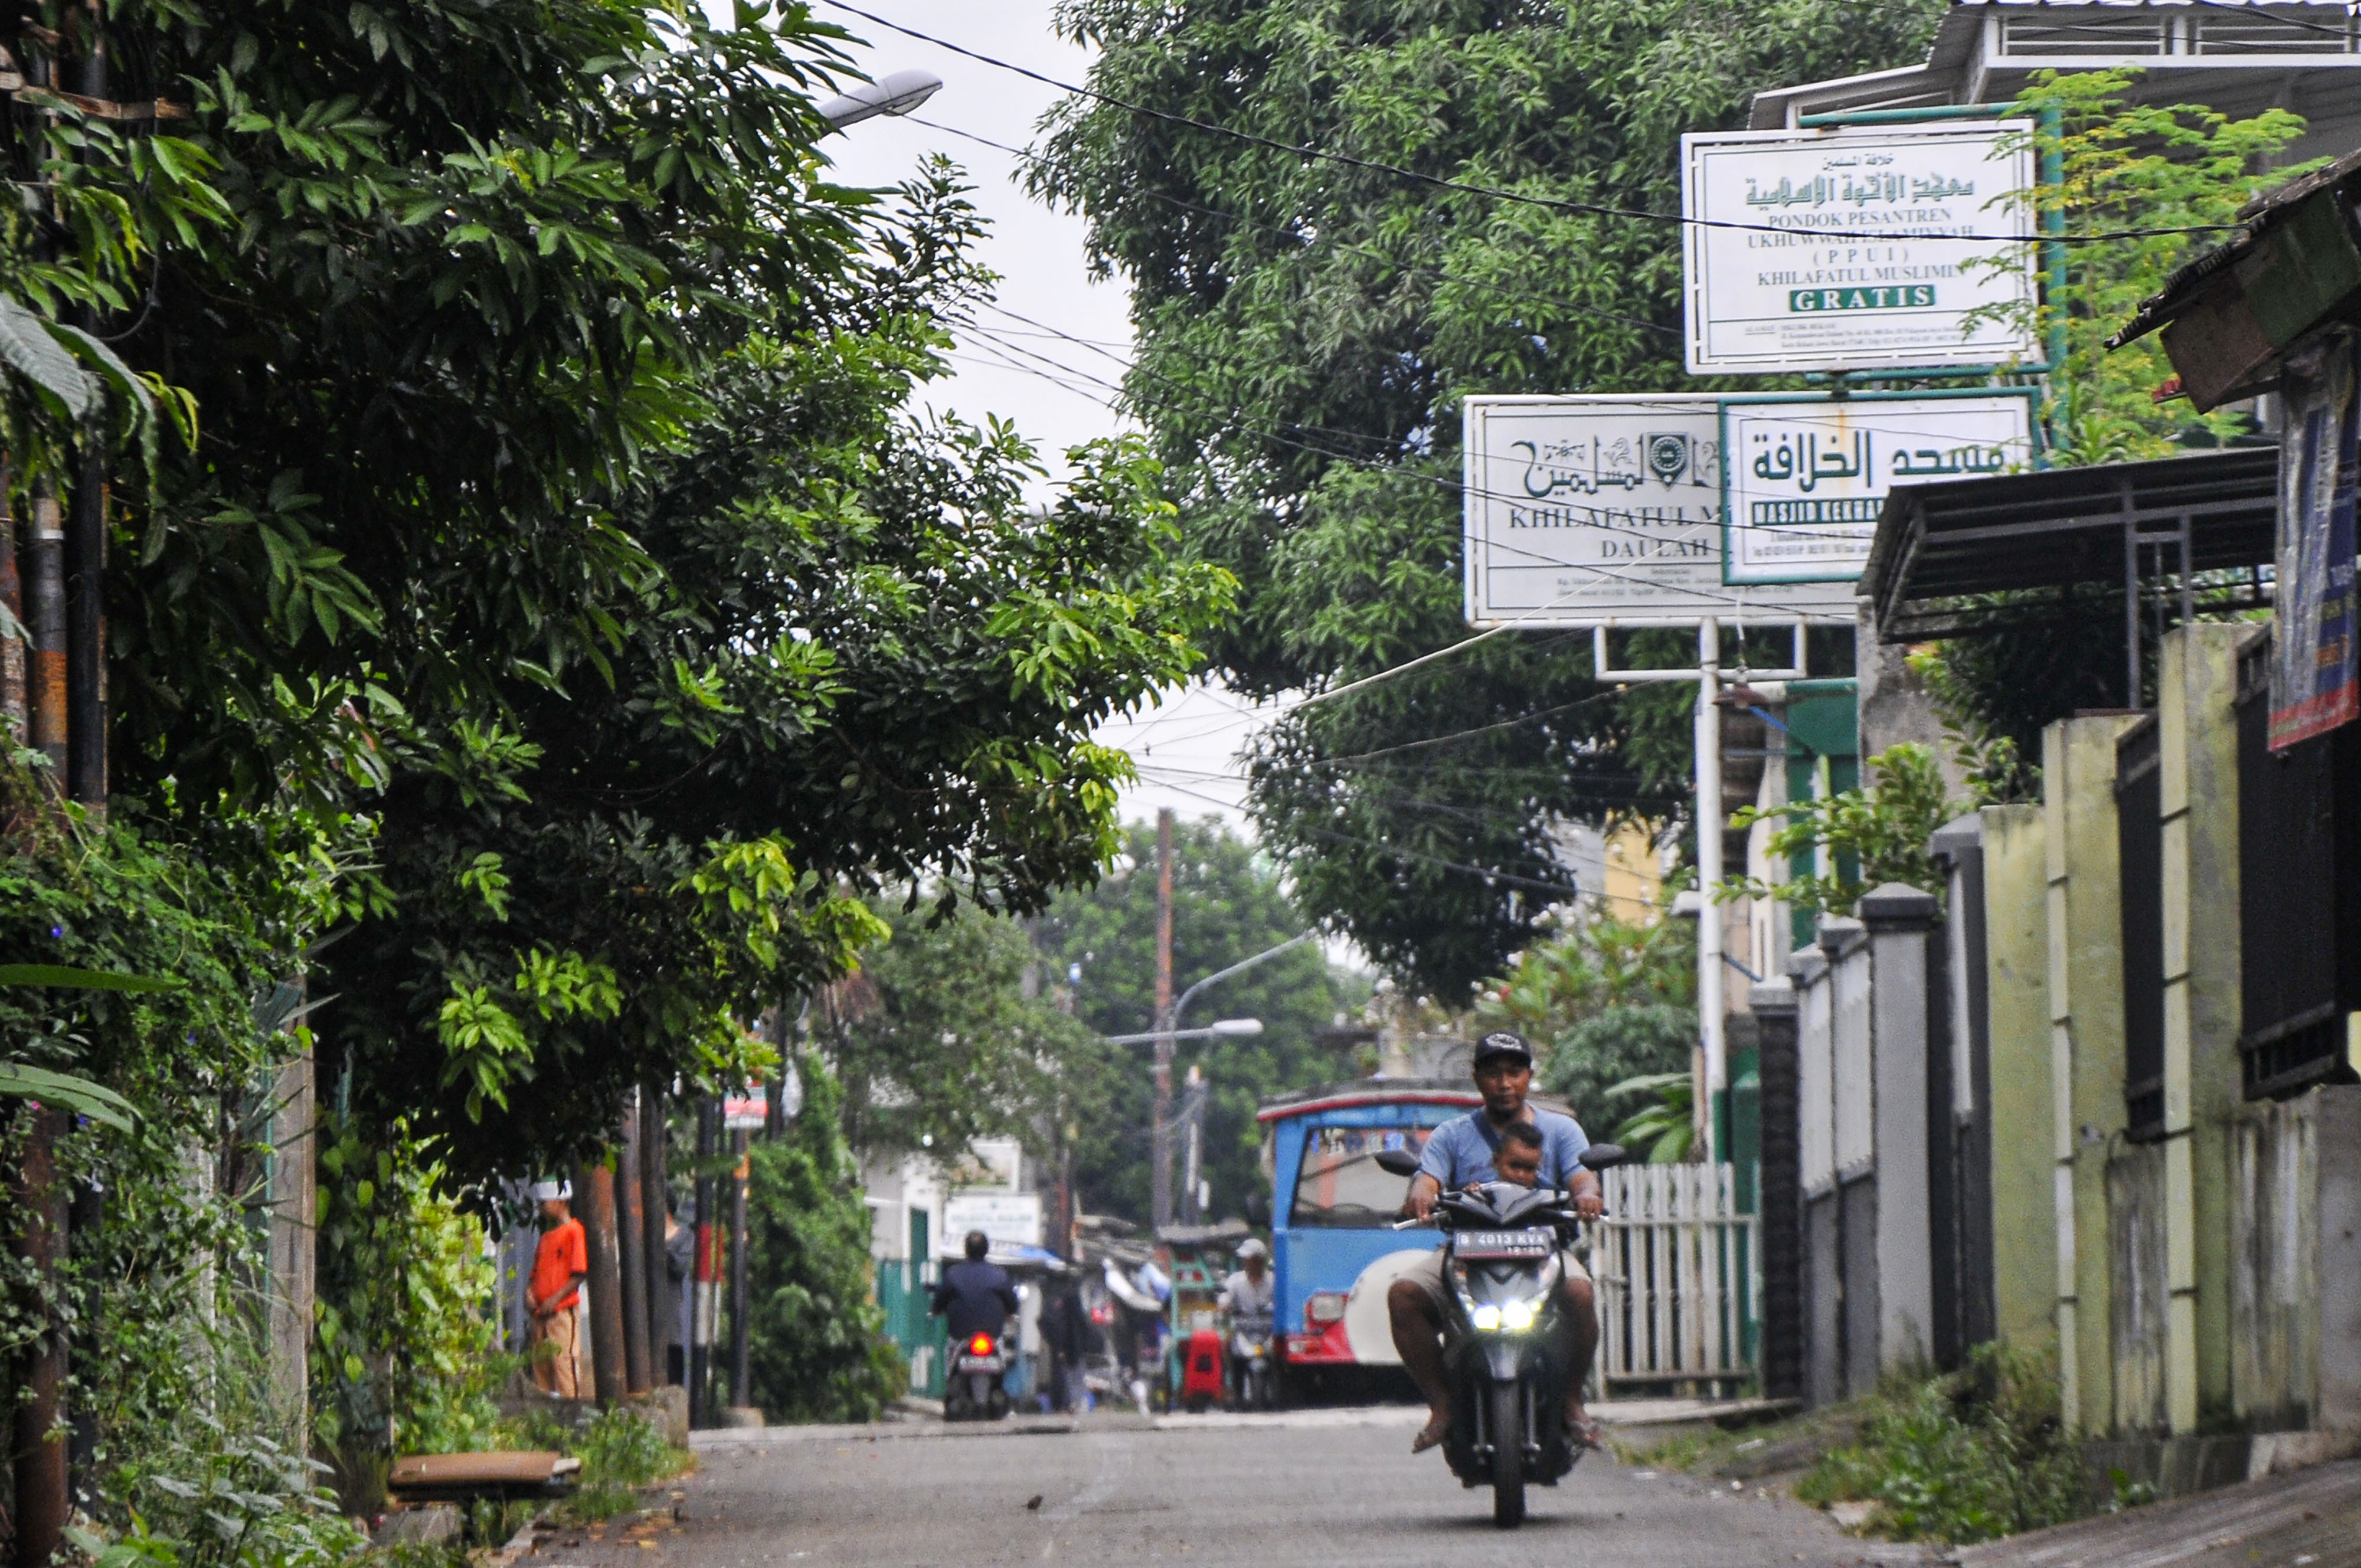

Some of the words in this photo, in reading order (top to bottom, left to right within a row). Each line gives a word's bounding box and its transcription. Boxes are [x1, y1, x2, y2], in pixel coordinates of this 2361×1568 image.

[1769, 212, 1843, 228] PONDOK
[1849, 208, 1953, 225] PESANTREN
[1748, 231, 1856, 248] UKHUWWAH
[1758, 267, 1869, 286] KHILAFATUL
[1796, 286, 1930, 311] GRATIS
[1754, 430, 1871, 492] الخلافة
[1509, 505, 1693, 528] KHILAFATUL
[1754, 502, 1816, 523] MASJID
[1602, 538, 1708, 558] DAULAH
[1479, 1234, 1512, 1245] 4013
